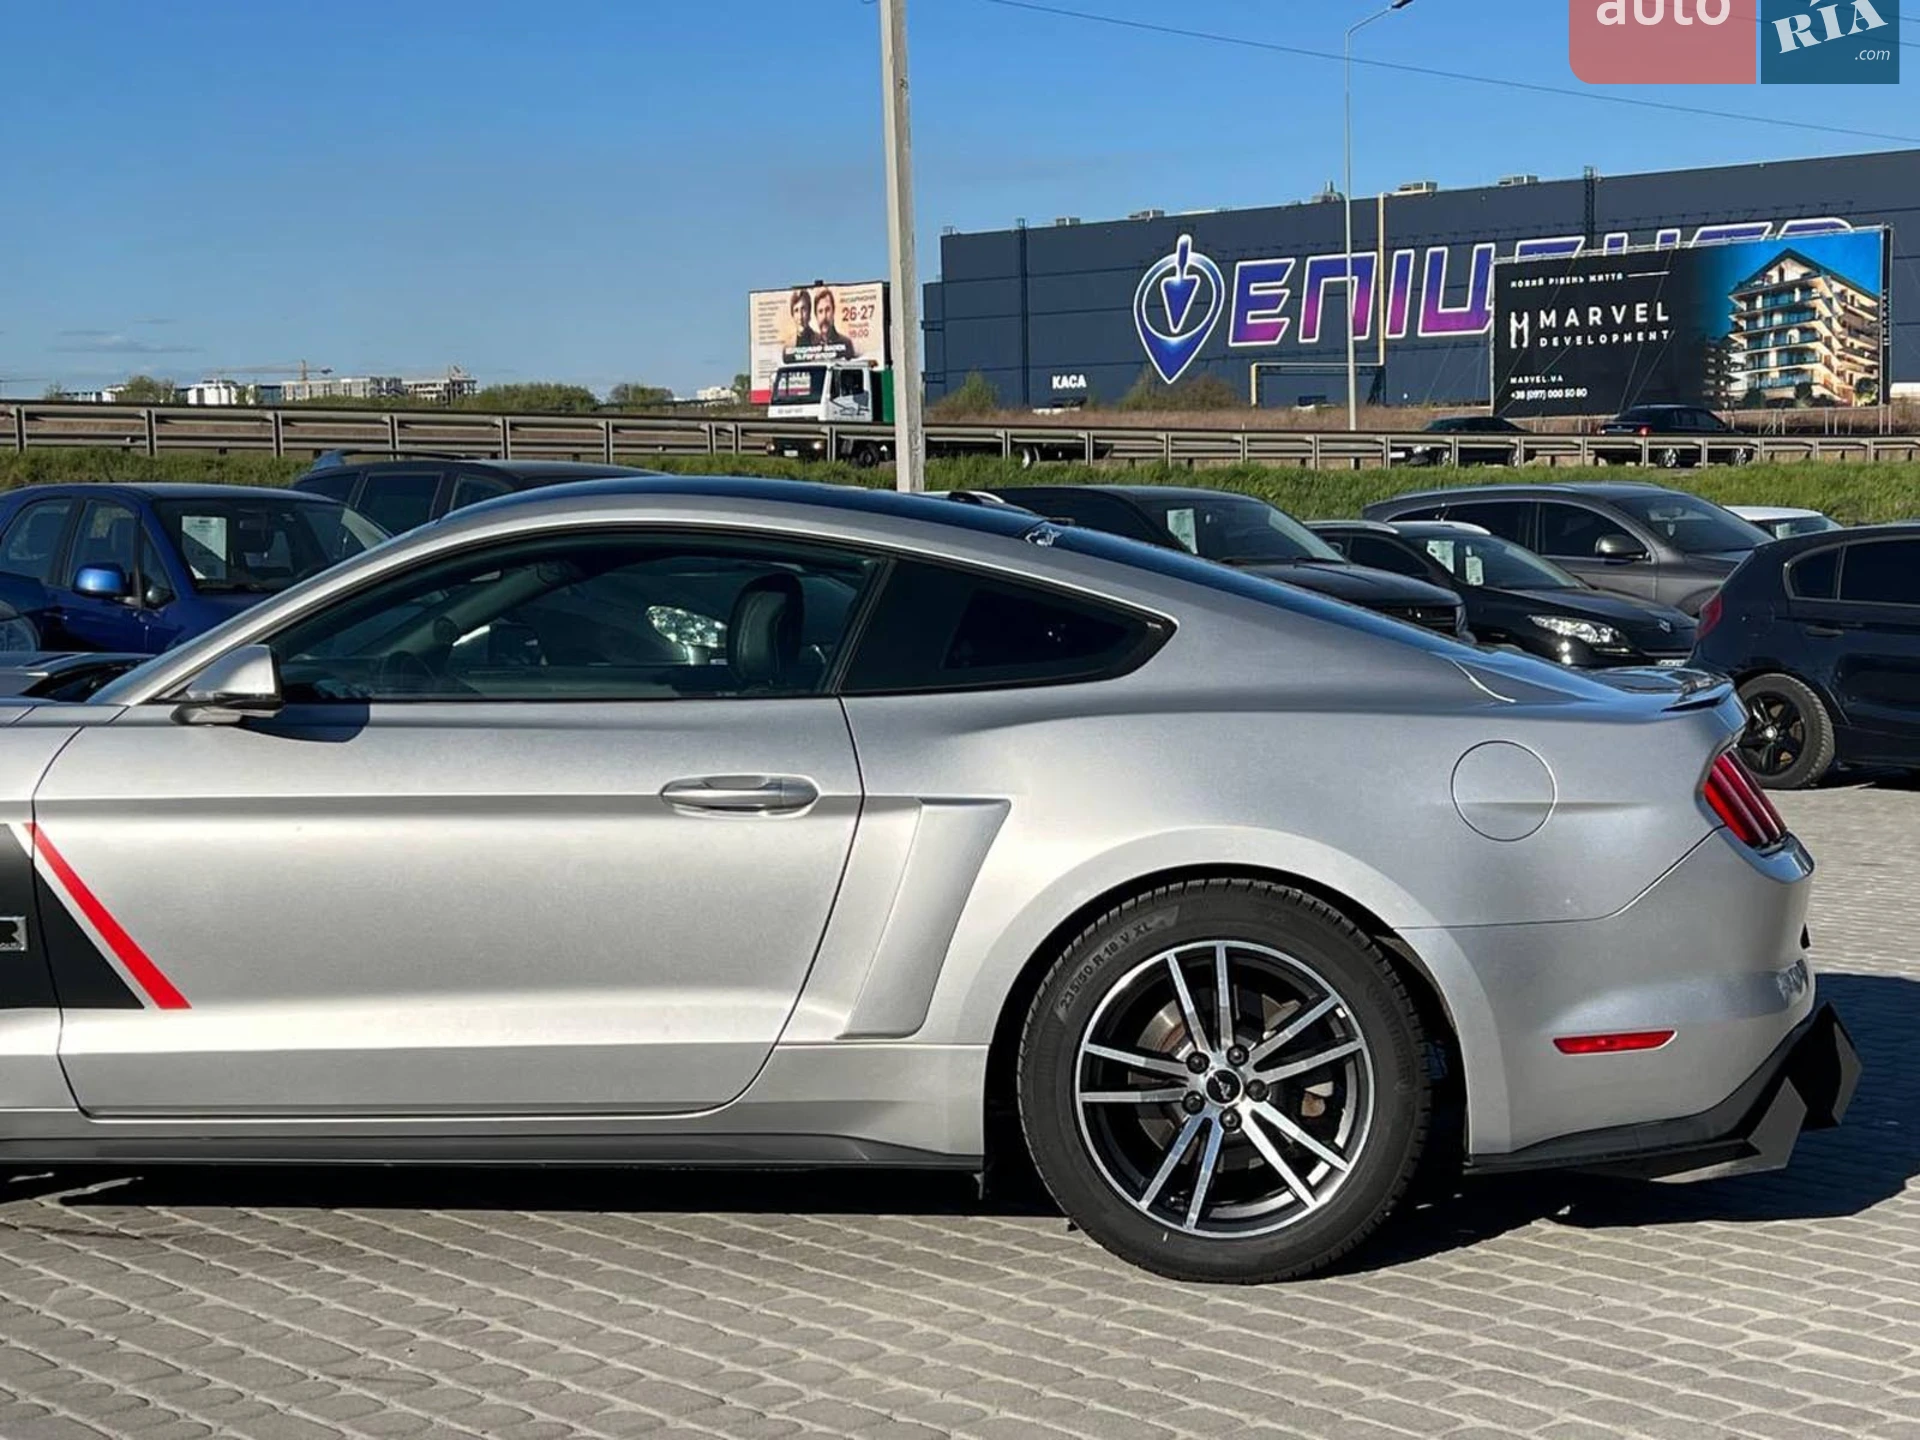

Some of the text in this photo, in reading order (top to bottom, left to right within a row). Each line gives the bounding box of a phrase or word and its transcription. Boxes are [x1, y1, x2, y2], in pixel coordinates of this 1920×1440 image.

[1539, 301, 1669, 329] MARVEL
[1539, 330, 1670, 347] DEVELOPMENT
[1051, 373, 1088, 390] КАСА
